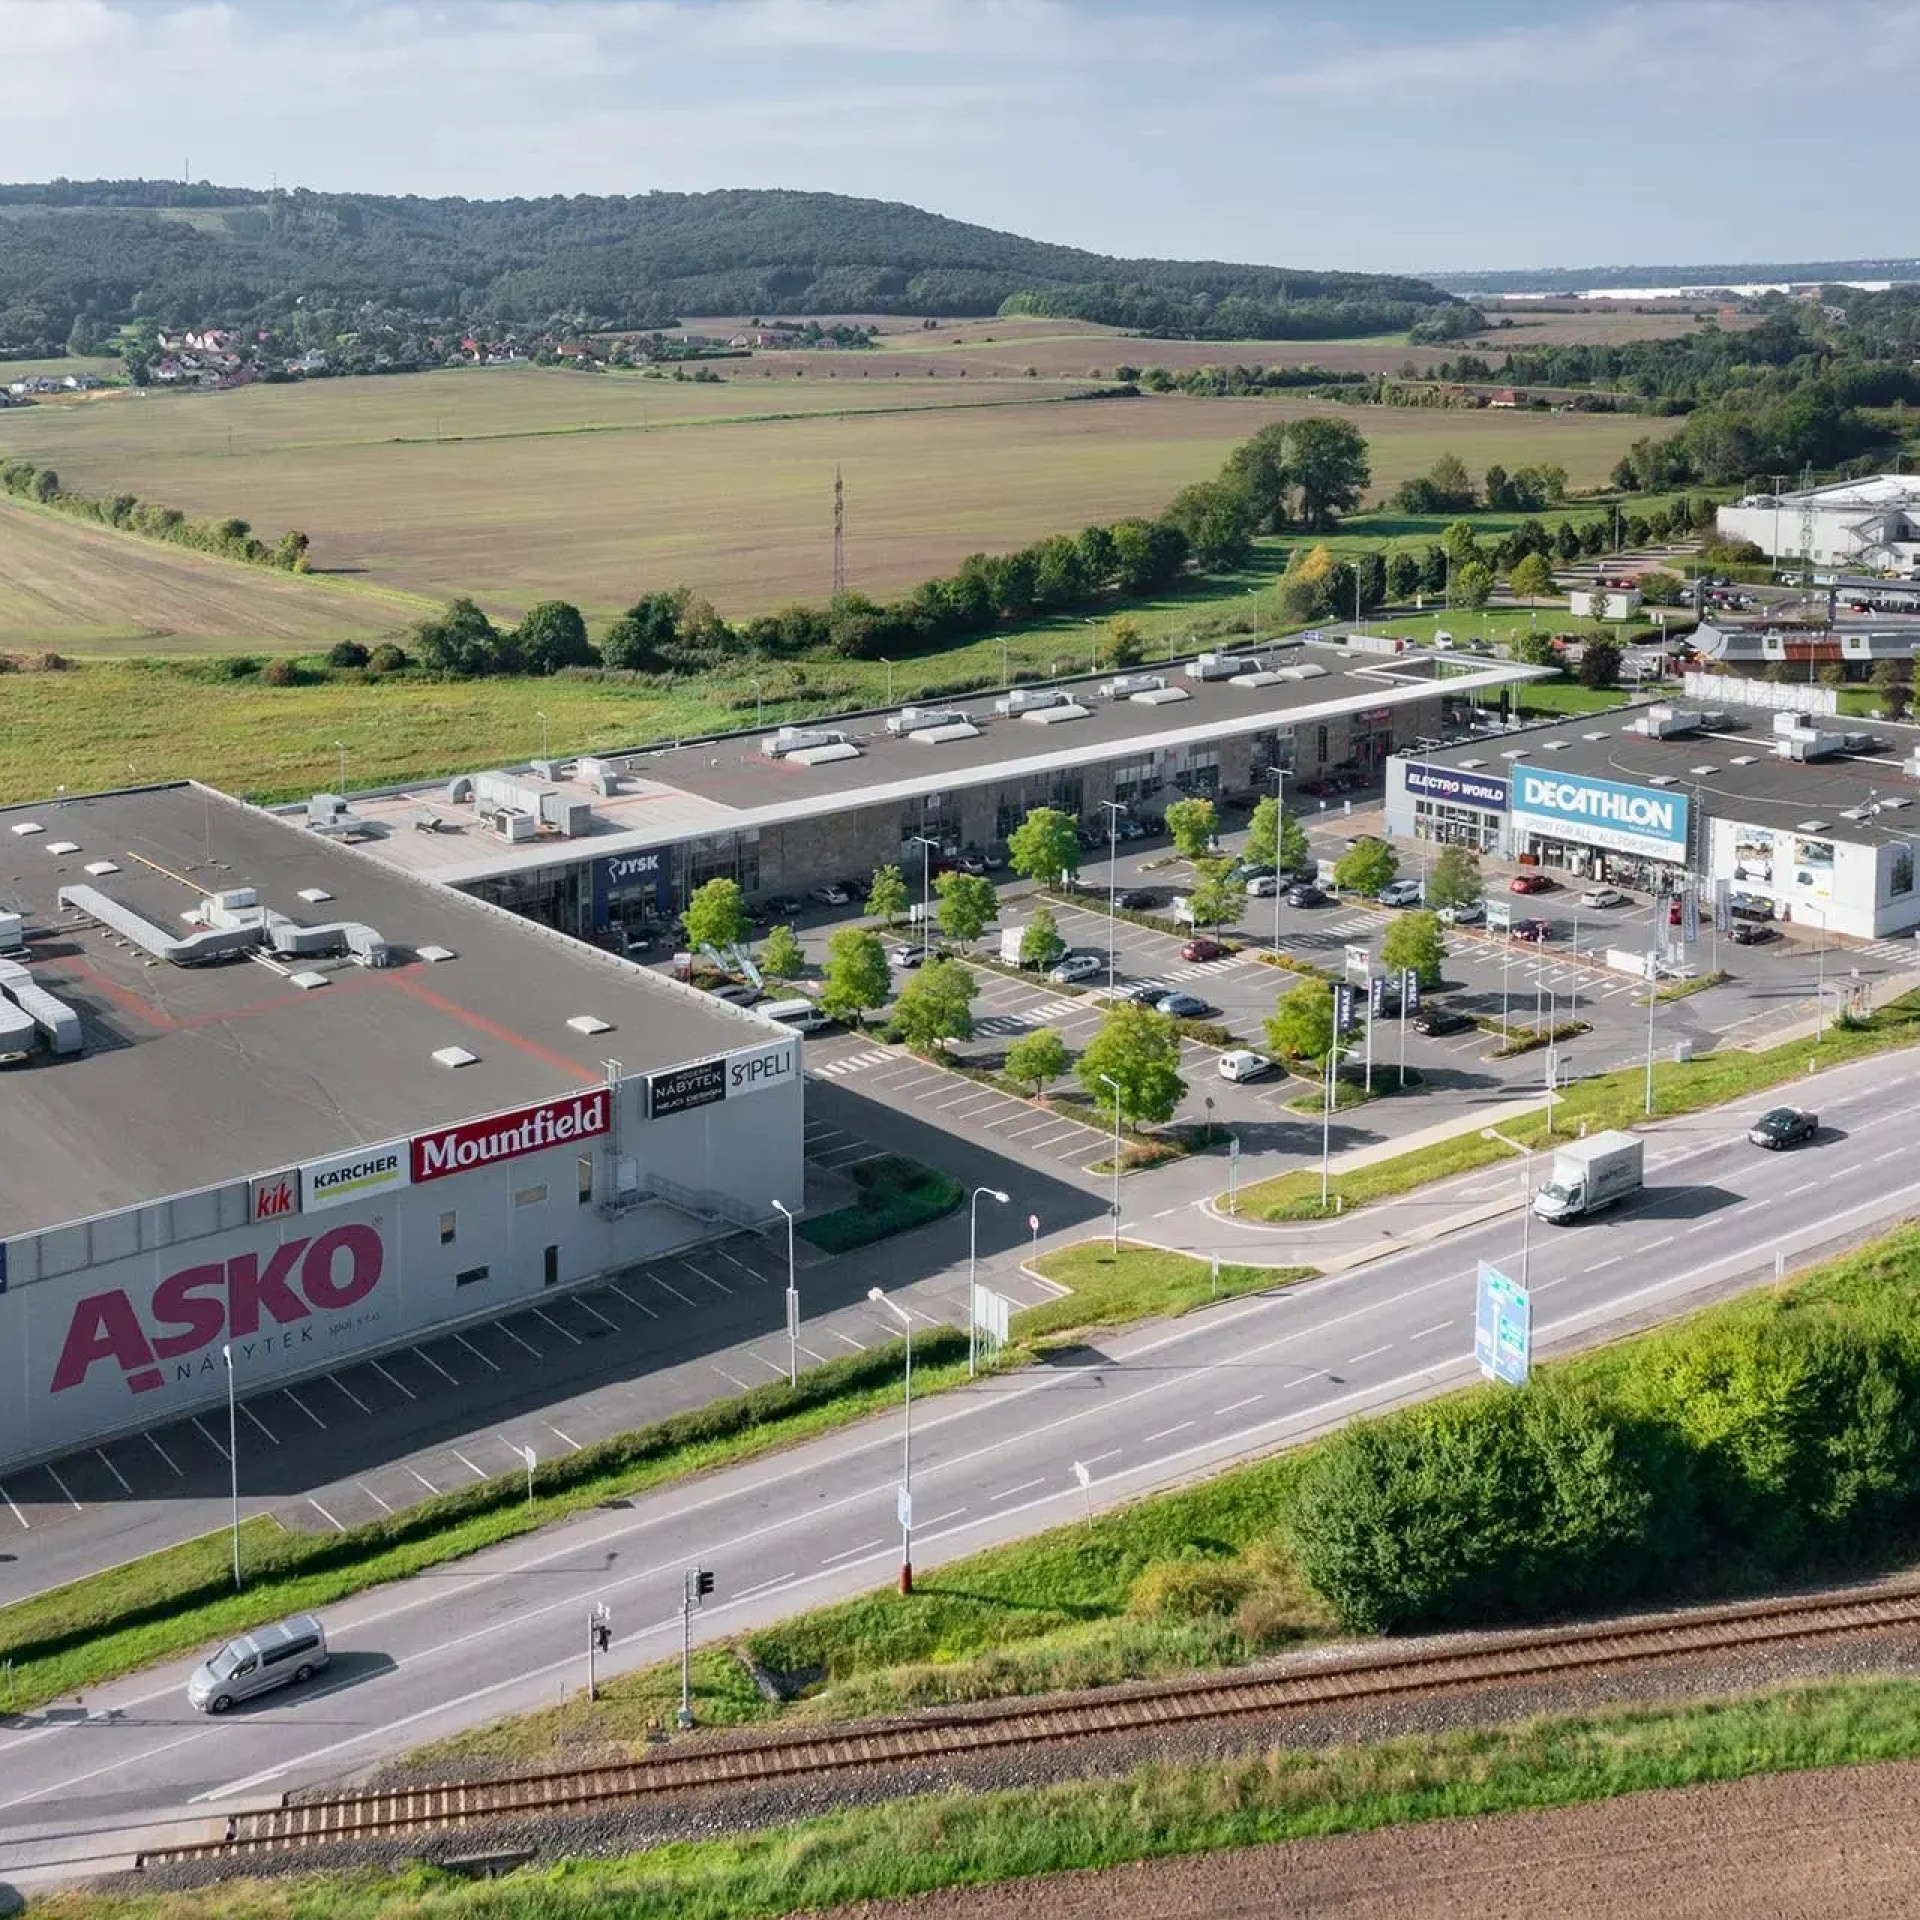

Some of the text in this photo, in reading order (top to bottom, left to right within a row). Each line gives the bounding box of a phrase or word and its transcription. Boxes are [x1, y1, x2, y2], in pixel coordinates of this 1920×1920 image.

[1408, 773, 1504, 801] ELECTRO WORLD
[1524, 777, 1673, 831] DECATHLON
[619, 854, 659, 876] JYSK
[656, 1071, 721, 1099] NÁBYTEK
[421, 1096, 604, 1176] Mountfield
[314, 1155, 398, 1188] KÄRCHER
[50, 1223, 384, 1393] ASKO
